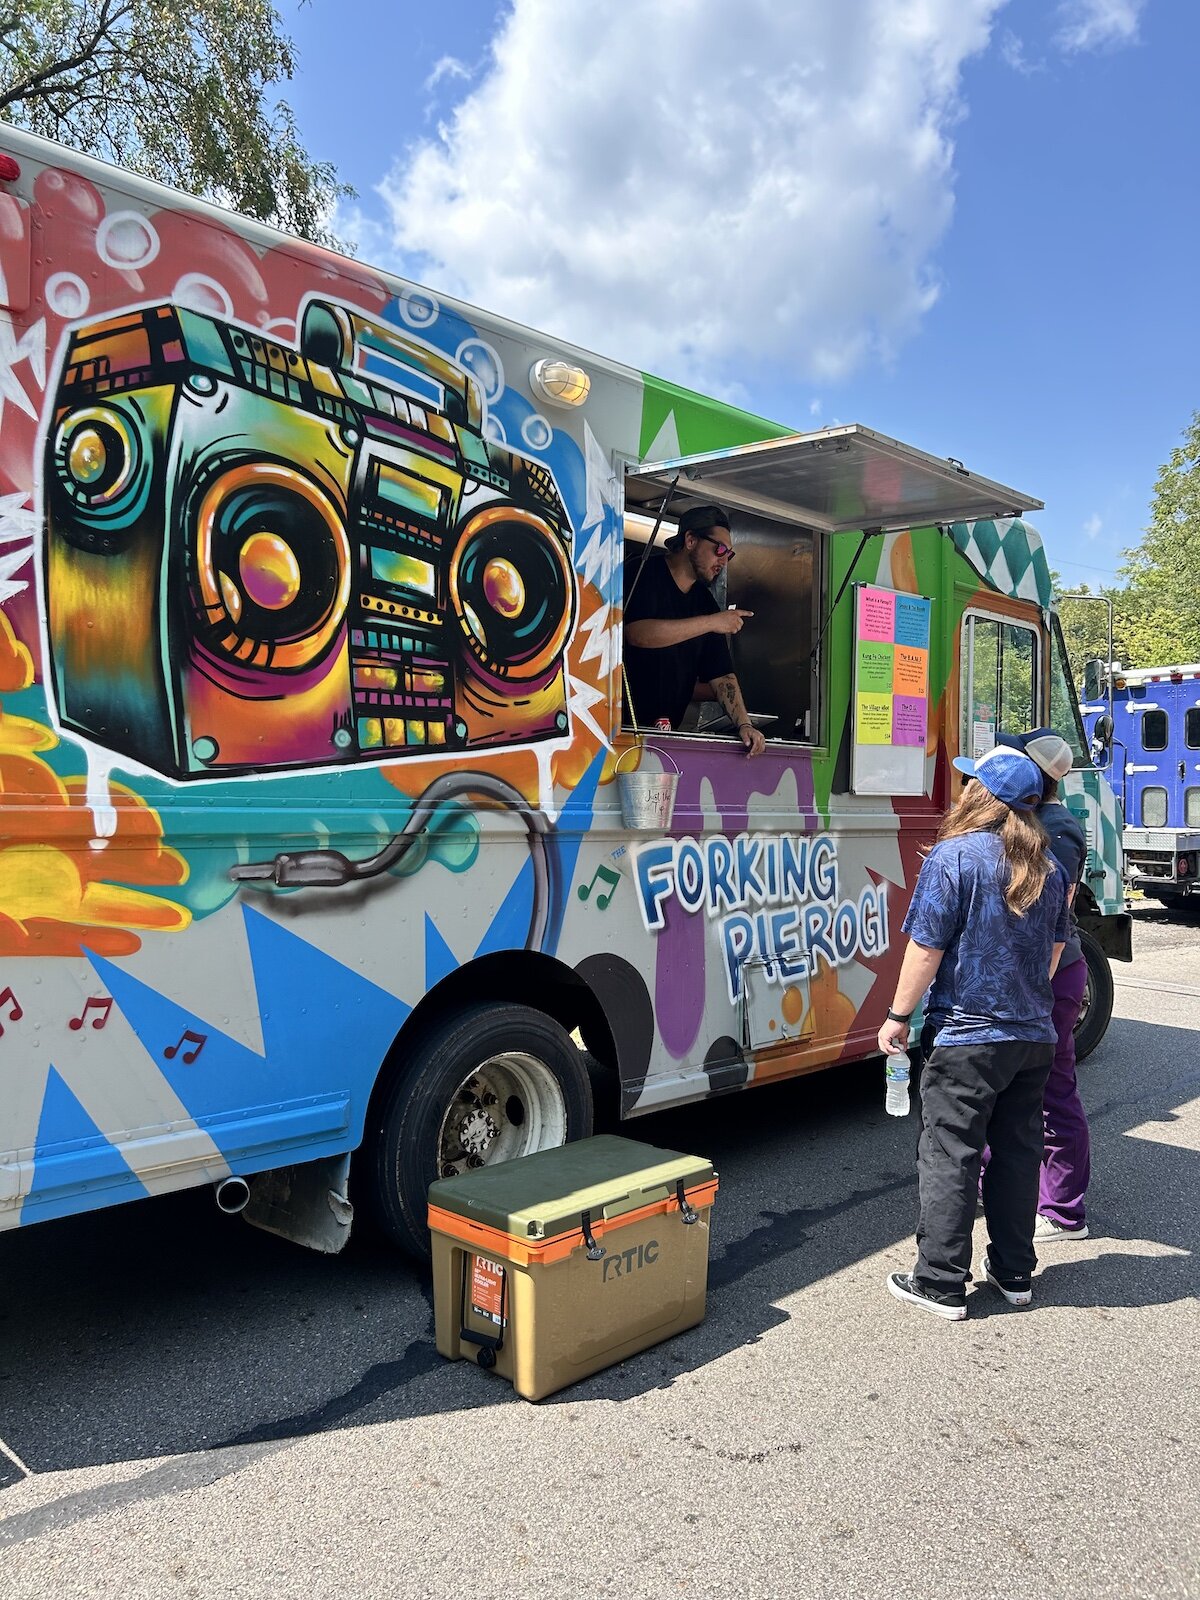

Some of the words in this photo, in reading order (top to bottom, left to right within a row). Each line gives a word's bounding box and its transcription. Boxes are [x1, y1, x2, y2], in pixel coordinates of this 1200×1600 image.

[662, 790, 672, 802] the
[611, 845, 626, 860] THE
[631, 834, 838, 929] FORKING
[721, 884, 889, 1002] PIEROGI
[476, 1255, 504, 1277] RTIC
[602, 1239, 660, 1283] RTIC
